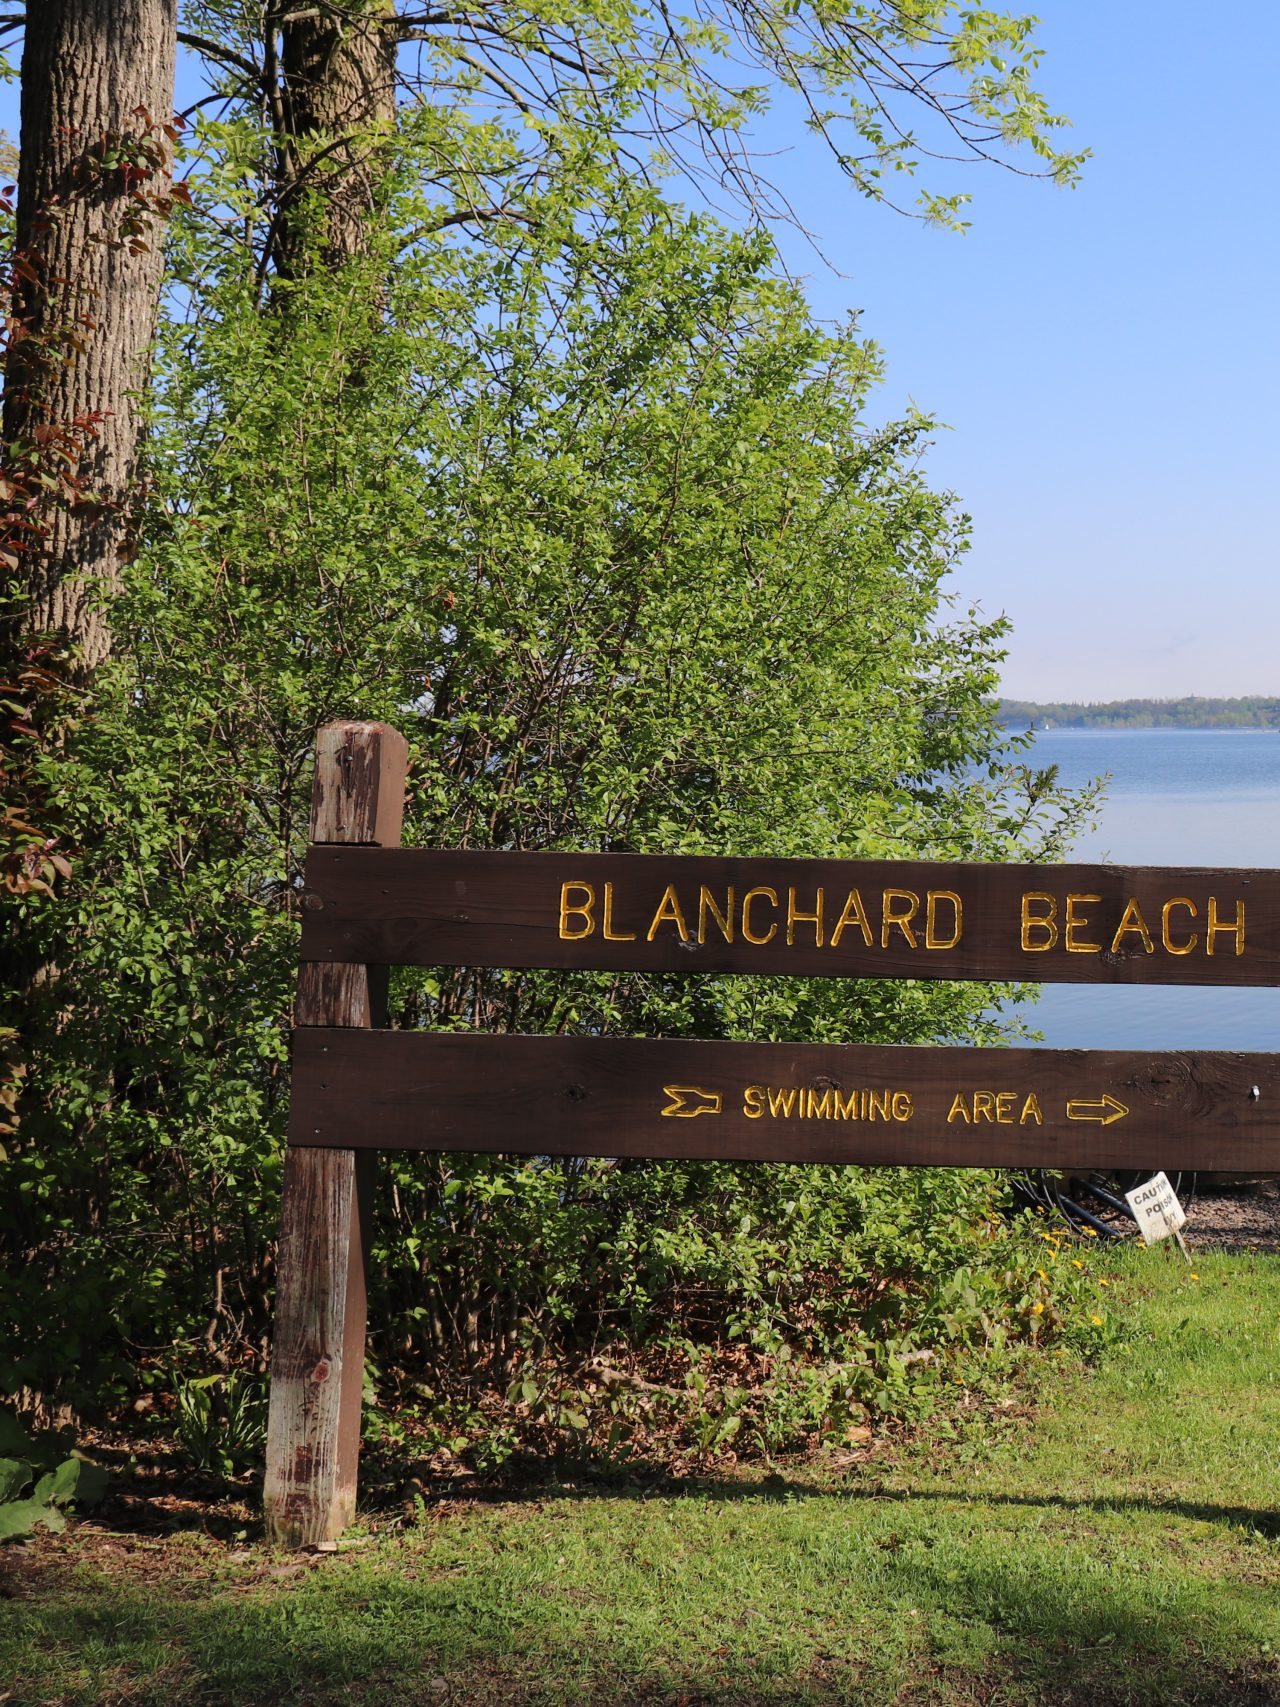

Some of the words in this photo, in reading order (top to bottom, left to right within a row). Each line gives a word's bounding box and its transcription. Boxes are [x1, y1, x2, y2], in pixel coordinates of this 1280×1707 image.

[557, 880, 964, 951] BLANCHARD
[1019, 891, 1246, 957] BEACH
[742, 1085, 915, 1123] SWIMMING
[946, 1090, 1043, 1125] AREA
